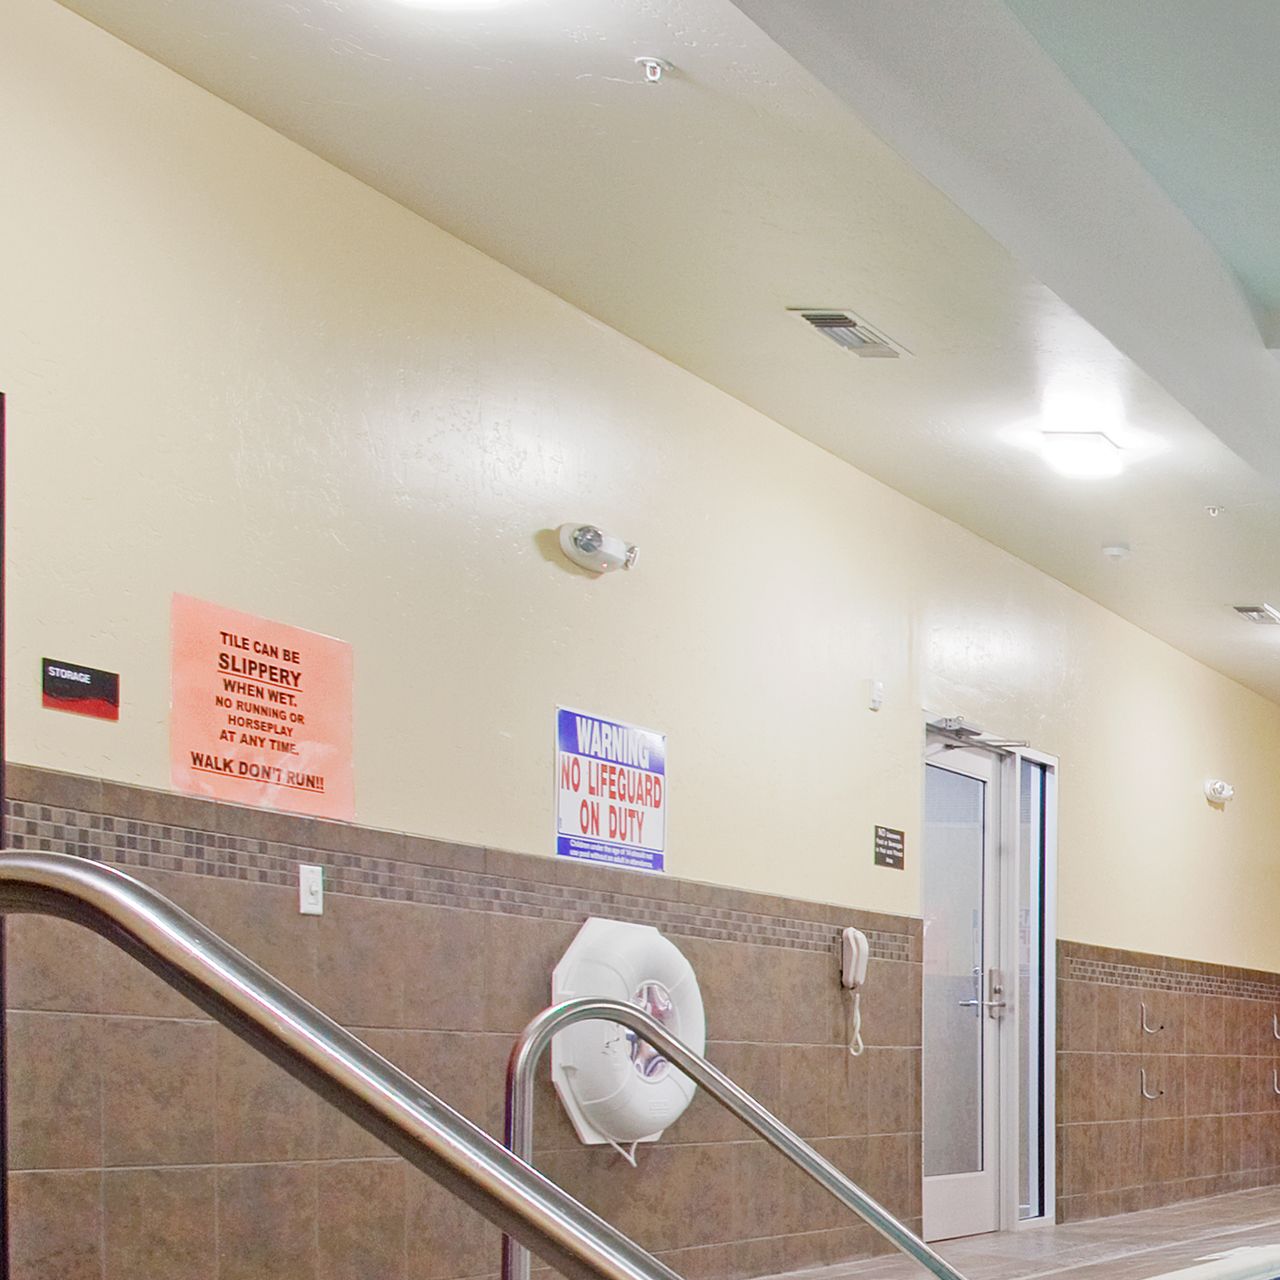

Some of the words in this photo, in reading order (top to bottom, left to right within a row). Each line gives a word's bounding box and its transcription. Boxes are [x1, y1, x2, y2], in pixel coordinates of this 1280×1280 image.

[219, 631, 250, 651] TILE
[253, 641, 279, 659] CAN
[283, 649, 300, 664] BE
[48, 666, 91, 685] STORAGE
[218, 652, 302, 688] SLIPPERY
[223, 678, 264, 699] WHEN
[268, 689, 298, 707] WET.
[215, 696, 232, 709] NO
[236, 700, 287, 721] RUNNING
[289, 712, 305, 725] OR
[228, 714, 294, 738] HORSEPLAY
[219, 729, 236, 743] AT
[239, 733, 266, 749] ANY
[269, 738, 299, 756] TIME.
[575, 715, 650, 769] WARNING
[190, 751, 234, 773] WALK
[238, 762, 282, 783] DON'T
[287, 771, 324, 790] RUN!!
[561, 756, 581, 793] NO
[588, 760, 662, 809] LIFEGUARD
[579, 798, 599, 836] ON
[609, 804, 645, 843] DUTY
